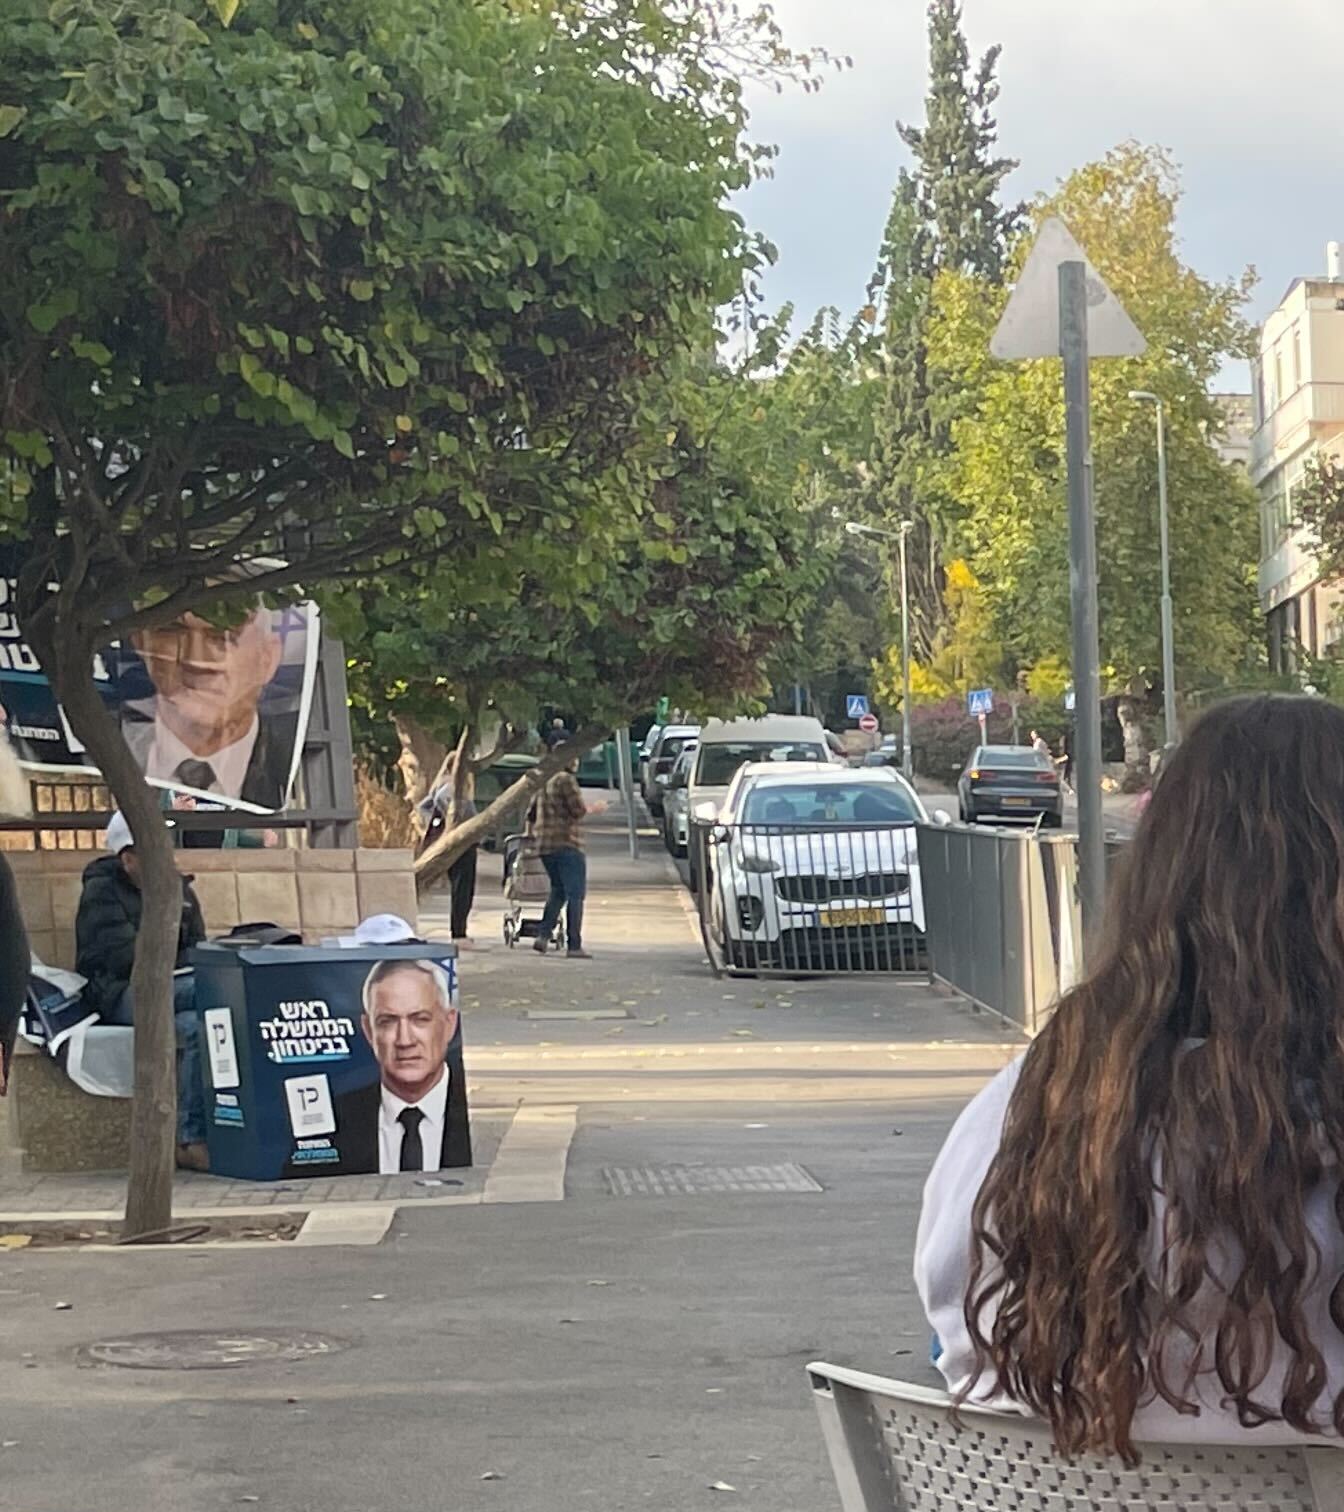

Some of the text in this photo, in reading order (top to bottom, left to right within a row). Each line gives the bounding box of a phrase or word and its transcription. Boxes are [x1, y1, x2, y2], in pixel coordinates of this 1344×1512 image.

[279, 1000, 330, 1020] ראש
[258, 1017, 355, 1040] הממשלה
[296, 1087, 320, 1112] כן
